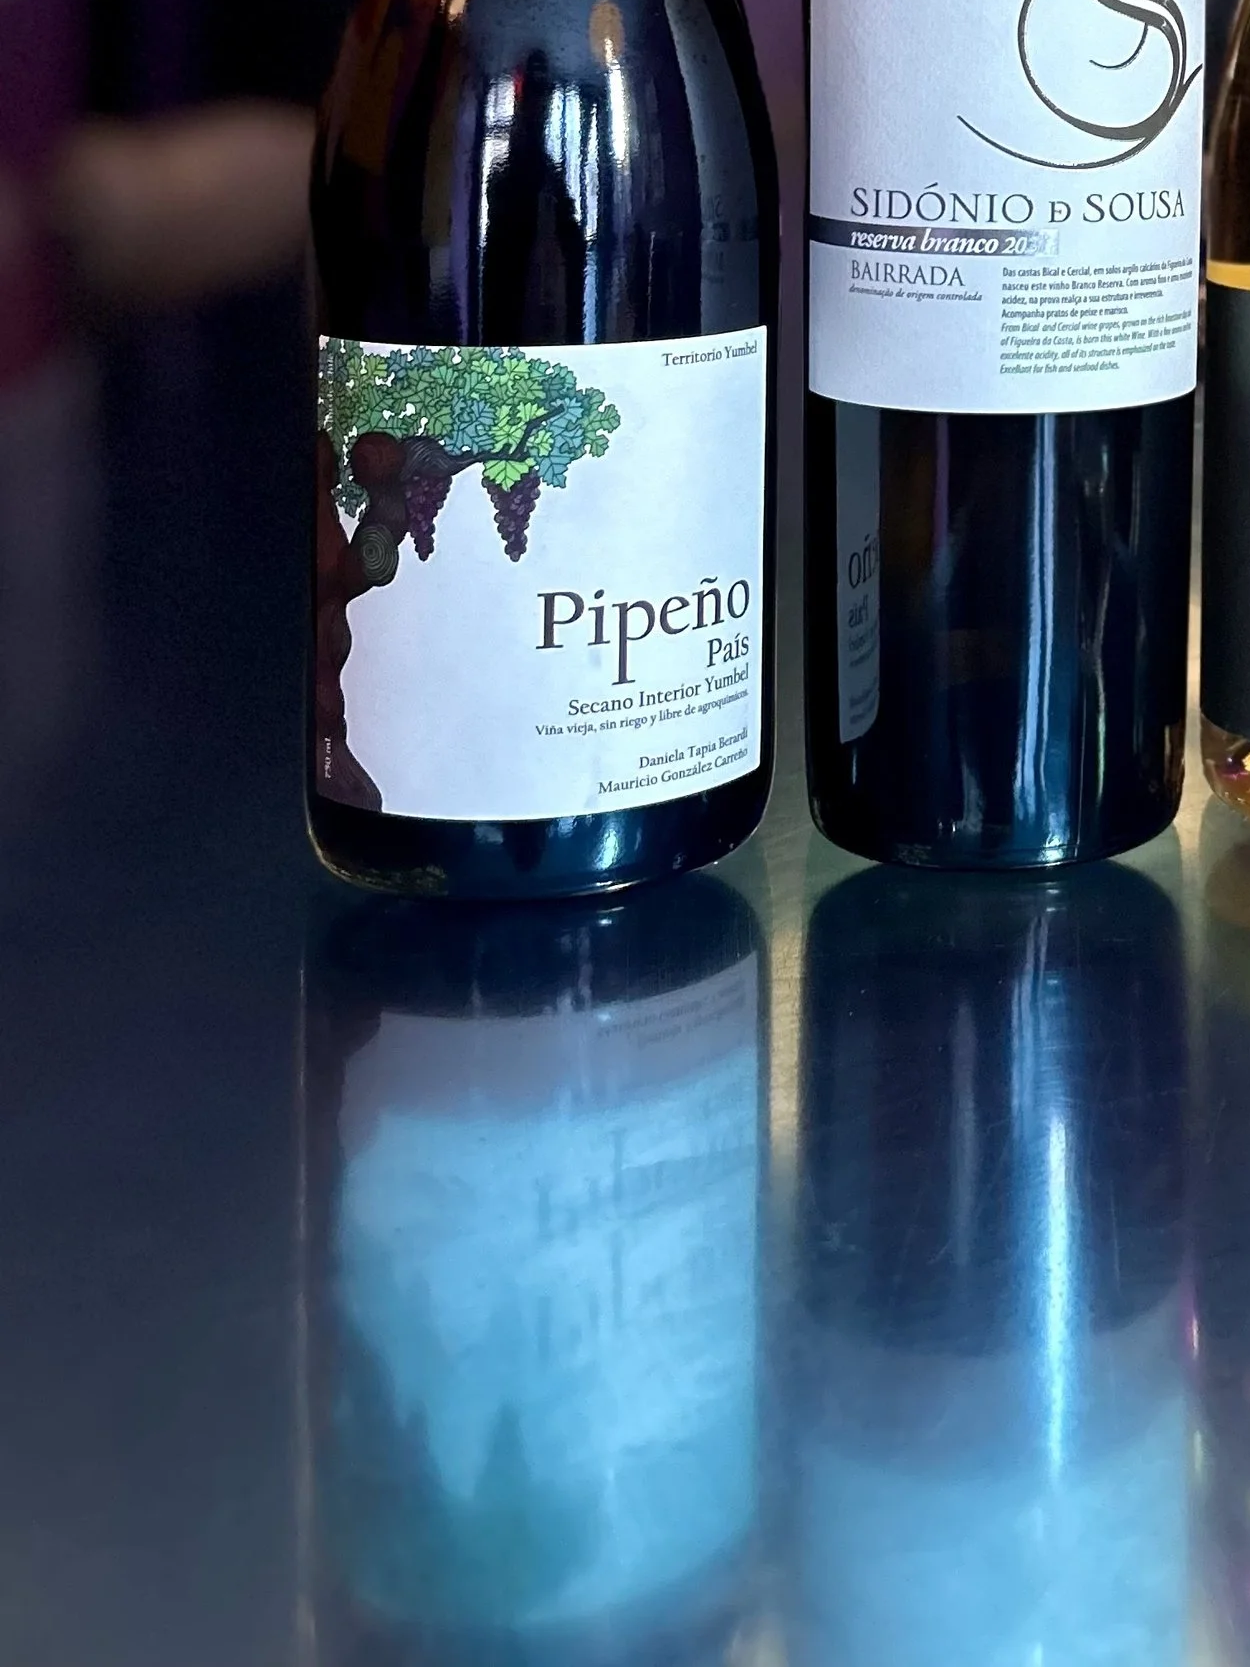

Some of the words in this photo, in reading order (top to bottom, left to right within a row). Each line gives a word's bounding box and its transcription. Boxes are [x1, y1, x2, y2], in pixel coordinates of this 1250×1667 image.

[850, 182, 1034, 224] SIDÓNIO
[1082, 189, 1185, 223] SOUSA
[850, 230, 915, 251] reserva
[920, 228, 1000, 254] branco
[851, 259, 966, 287] BAIRRADA
[1002, 267, 1017, 277] Das
[1018, 267, 1041, 277] castas
[1042, 266, 1060, 277] Bical
[1002, 283, 1029, 291] nasceu
[1031, 282, 1047, 291] este
[1049, 281, 1070, 290] vinho
[1071, 280, 1096, 290] Branco
[895, 289, 905, 297] de
[906, 291, 935, 303] origem
[936, 292, 983, 302] controlada
[1029, 296, 1039, 304] na
[1001, 309, 1045, 321] Acompanha
[1046, 309, 1069, 320] pratos
[1069, 308, 1079, 317] de
[1001, 322, 1021, 332] From
[1042, 322, 1057, 332] and
[661, 348, 722, 367] Territorio
[724, 339, 758, 359] Yumbel
[1000, 336, 1011, 346] of
[535, 576, 751, 686] Pipeño
[705, 631, 750, 669] País
[567, 686, 634, 718] Secano
[638, 683, 701, 708] Interior
[704, 663, 749, 694] Yumbel
[535, 724, 564, 736] Viña
[566, 722, 597, 736] vieja,
[599, 719, 617, 731] sin
[619, 715, 648, 729] riego
[649, 714, 657, 727] y
[659, 708, 683, 722] libre
[684, 703, 696, 716] de
[639, 748, 685, 769] Daniela
[688, 741, 717, 759] Tapia
[598, 775, 658, 795] Mauricio
[660, 761, 713, 783] González
[714, 746, 749, 769] Carreño
